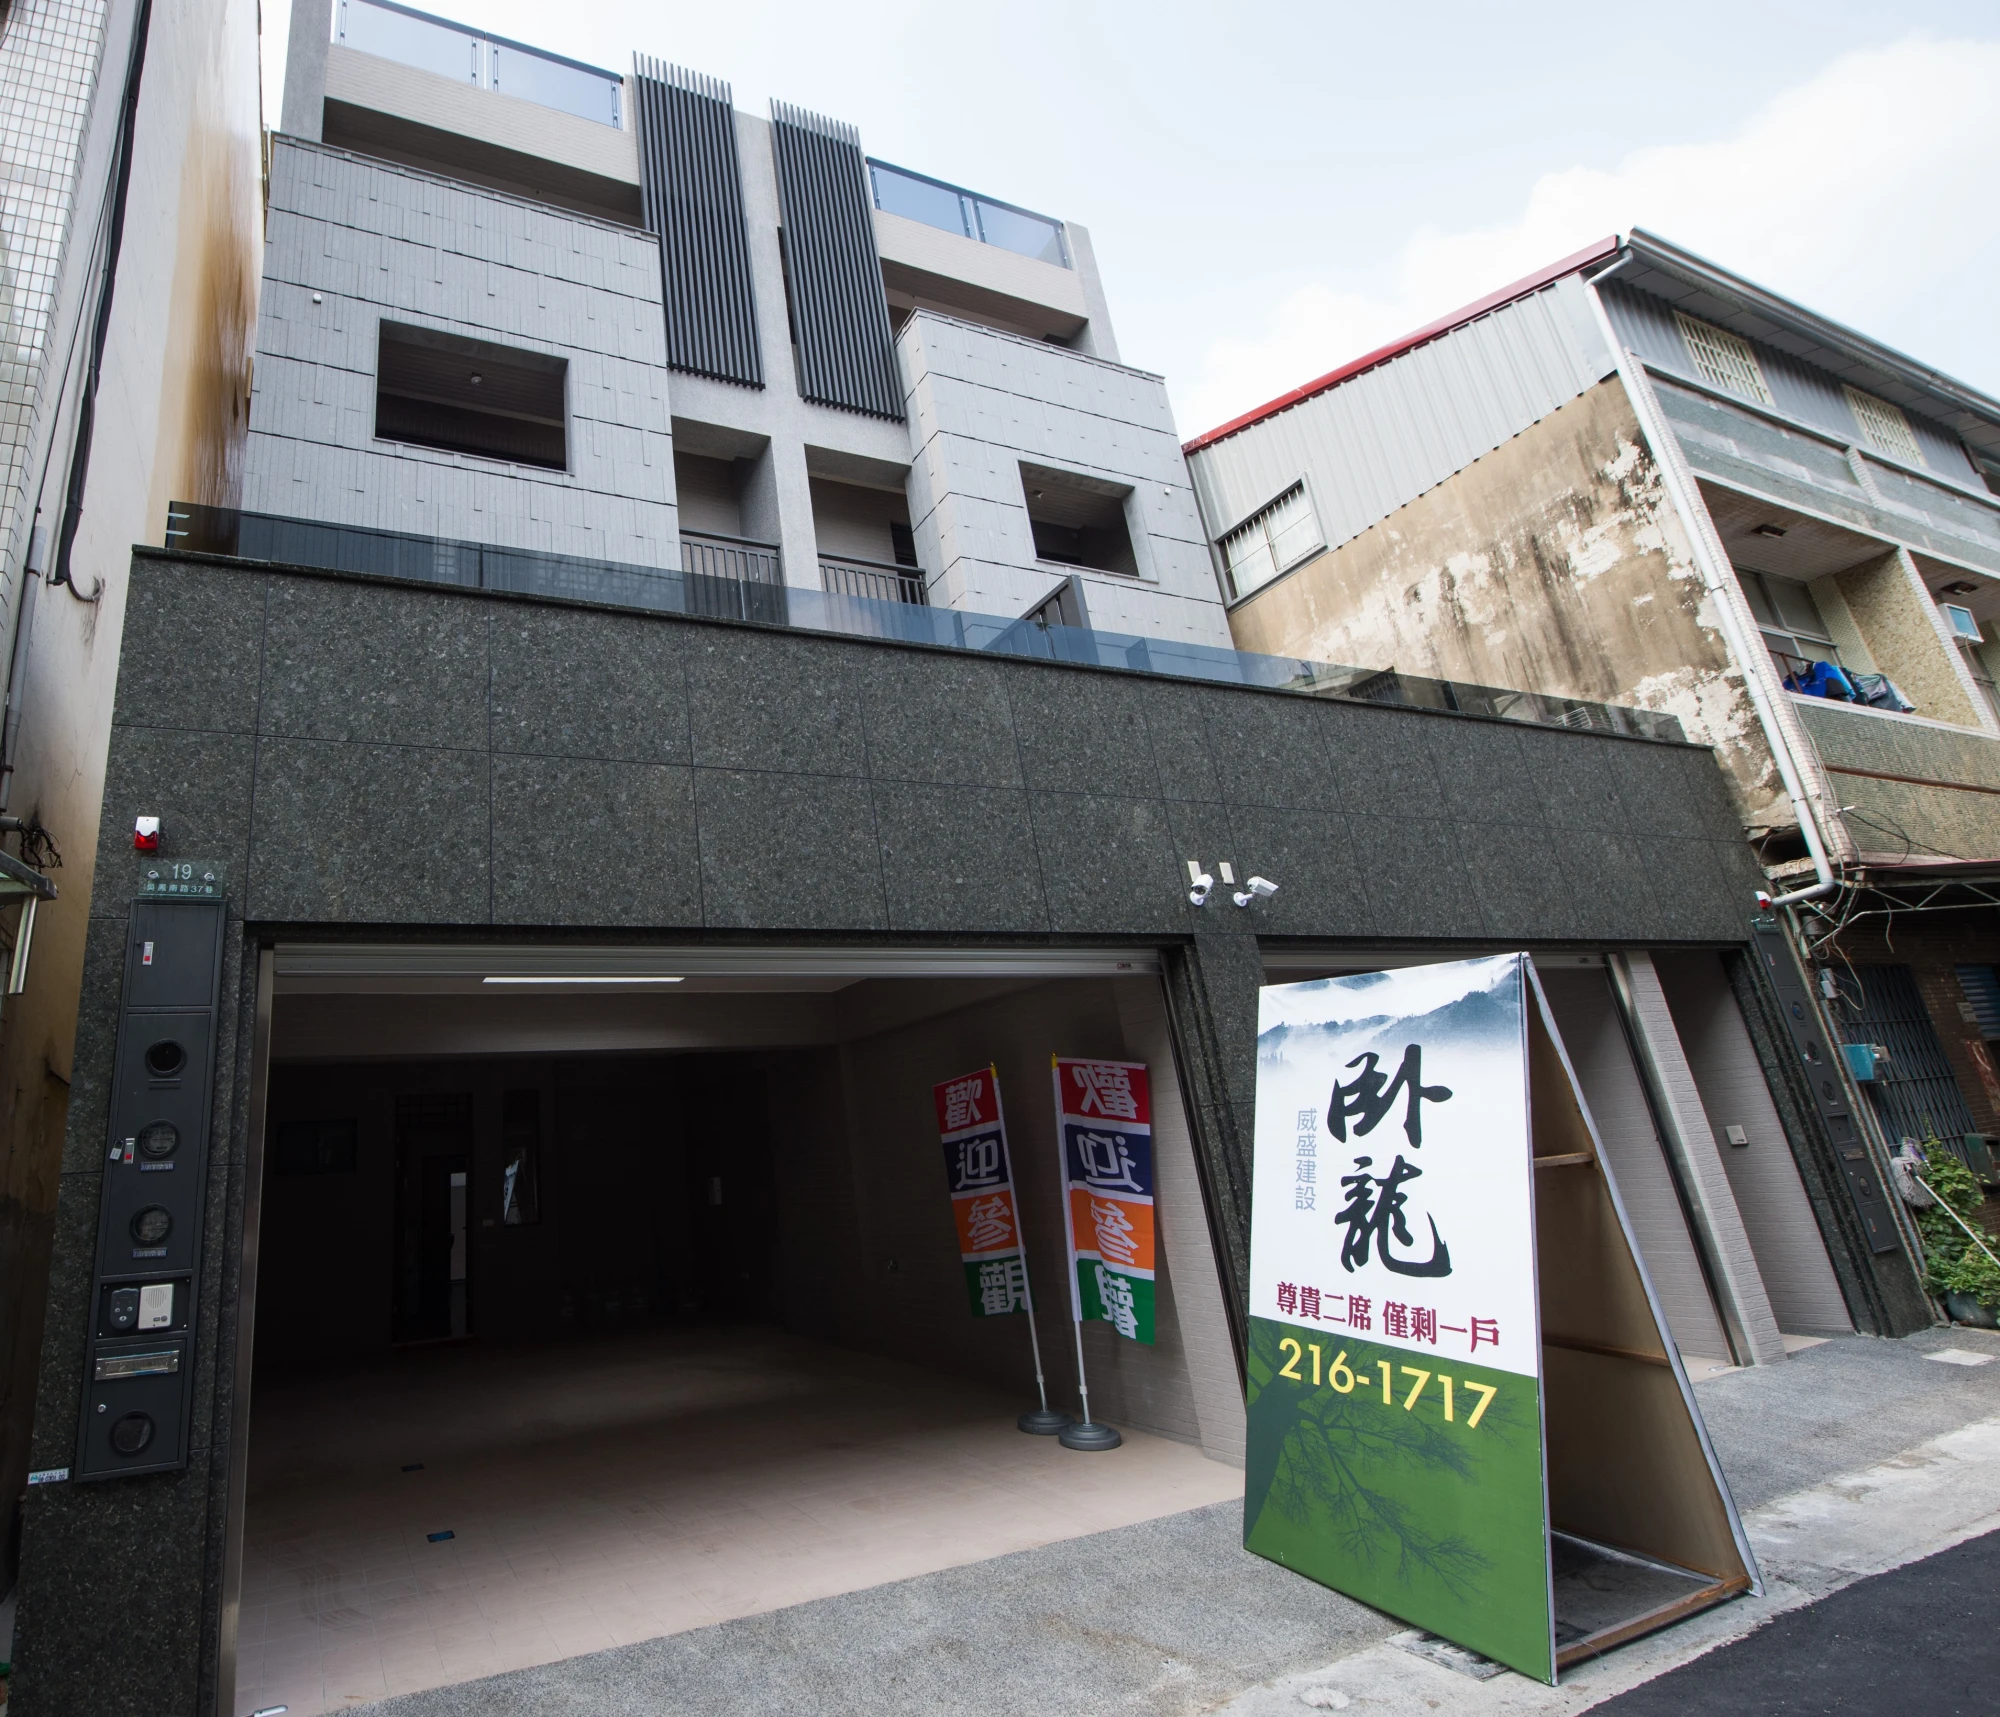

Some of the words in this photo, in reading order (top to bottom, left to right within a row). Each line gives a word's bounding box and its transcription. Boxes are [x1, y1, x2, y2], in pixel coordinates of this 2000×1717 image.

[172, 863, 192, 880] 19
[1294, 1107, 1318, 1212] 威盛建設
[1276, 1281, 1372, 1331] 尊貴二席
[1278, 1337, 1498, 1429] 216-1717
